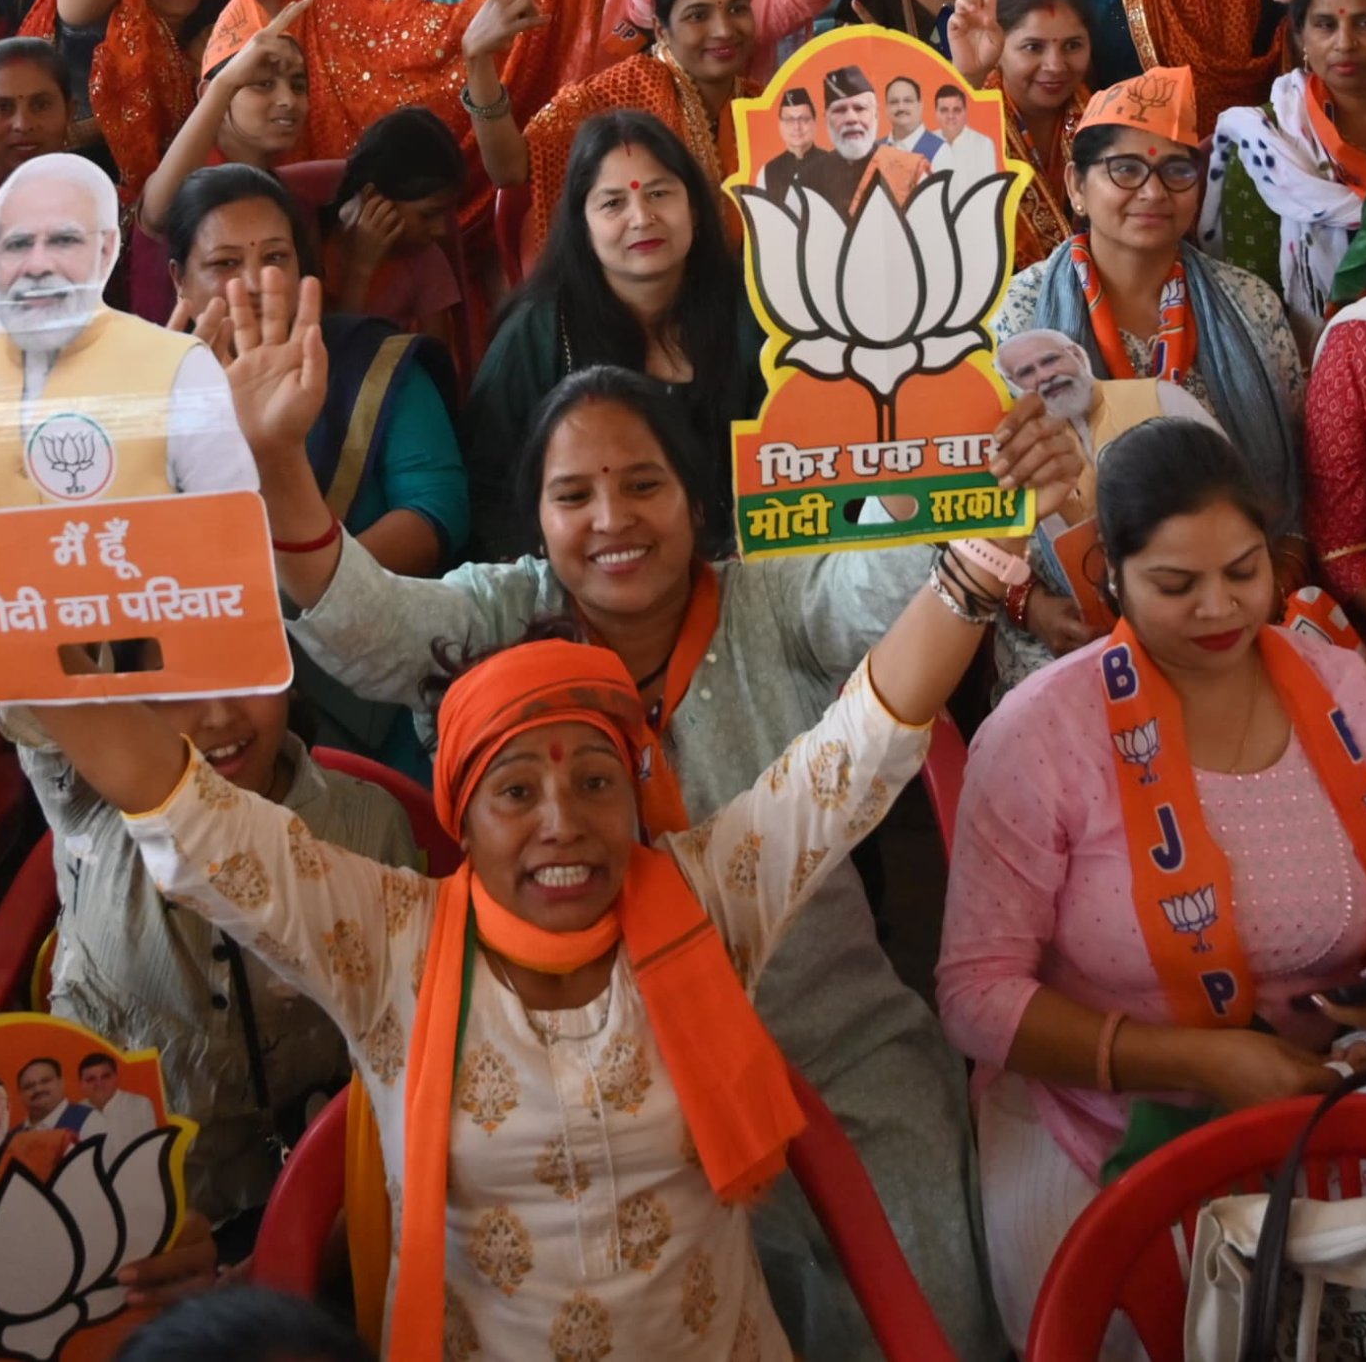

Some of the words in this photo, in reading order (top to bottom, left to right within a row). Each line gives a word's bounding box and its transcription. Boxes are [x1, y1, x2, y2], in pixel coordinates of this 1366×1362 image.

[756, 441, 840, 486] फिर
[846, 438, 928, 475] एक
[746, 492, 834, 541] मोदी
[929, 486, 1018, 523] सरकार
[49, 520, 90, 566] मैं
[94, 517, 142, 579] हूँ
[55, 594, 111, 628] का
[117, 576, 245, 623] परिवार
[1101, 641, 1139, 703] B
[1149, 802, 1185, 873] J
[1200, 969, 1239, 1016] P
